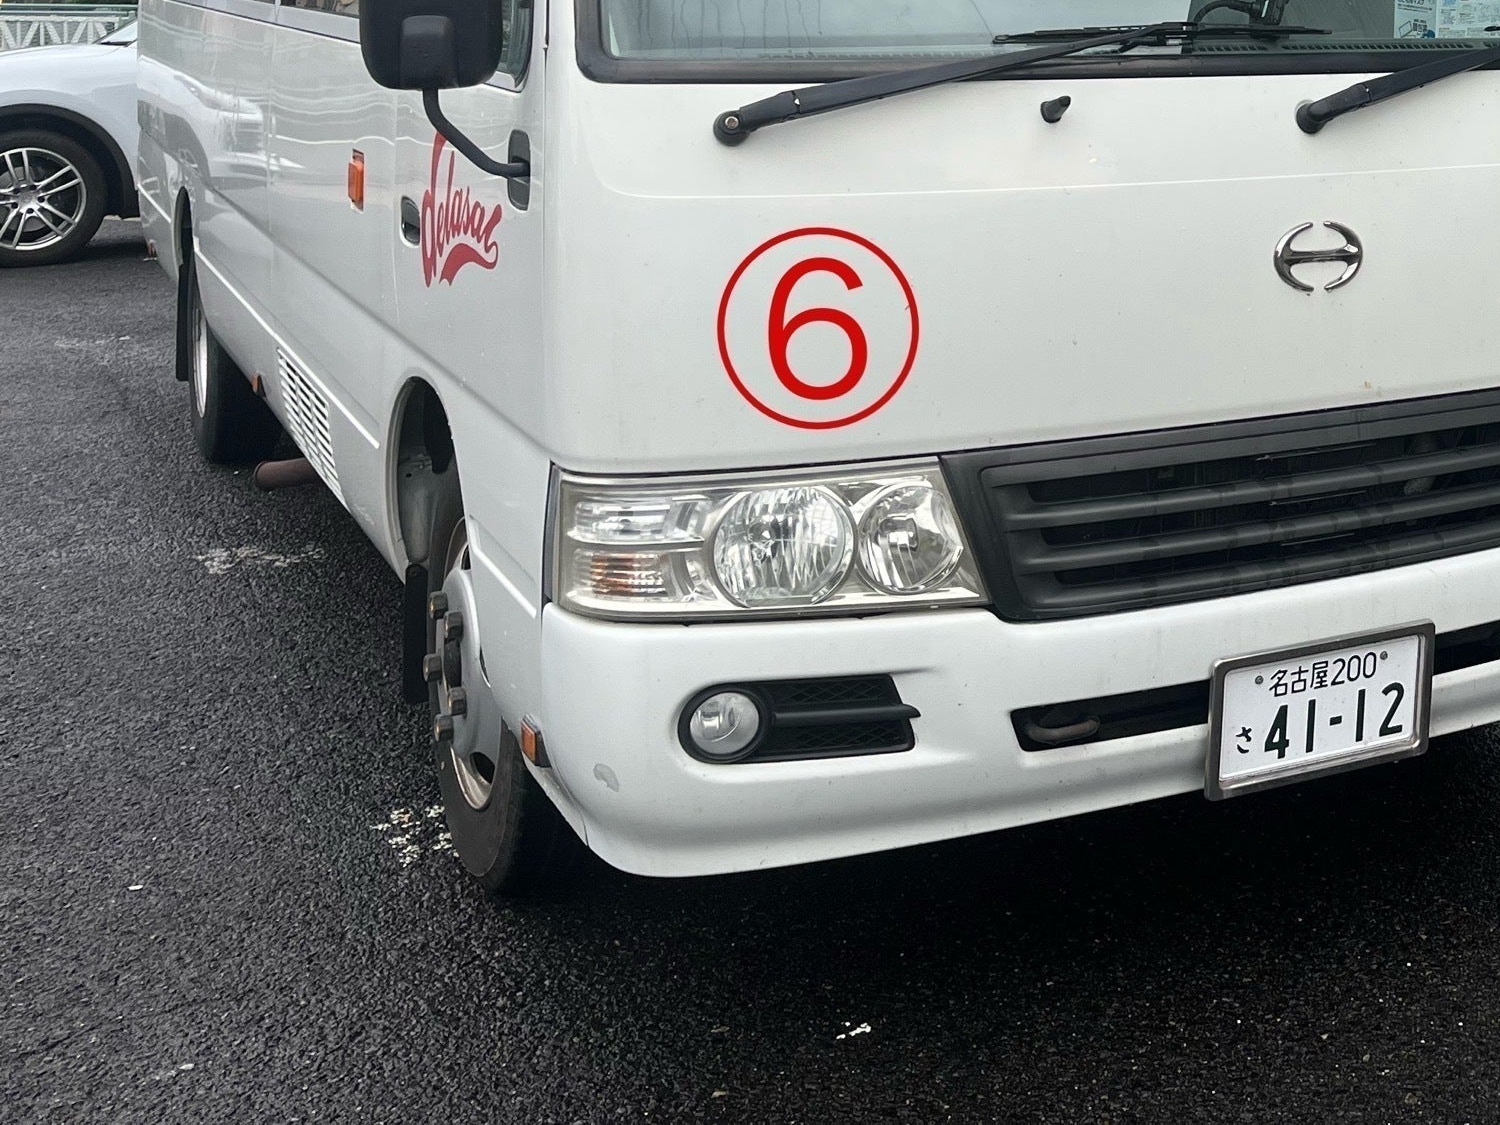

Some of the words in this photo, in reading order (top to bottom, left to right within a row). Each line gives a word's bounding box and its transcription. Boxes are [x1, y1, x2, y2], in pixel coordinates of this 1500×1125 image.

[1269, 651, 1377, 697] 名古屋200
[1236, 726, 1252, 754] さ
[1264, 681, 1405, 759] 41-12
